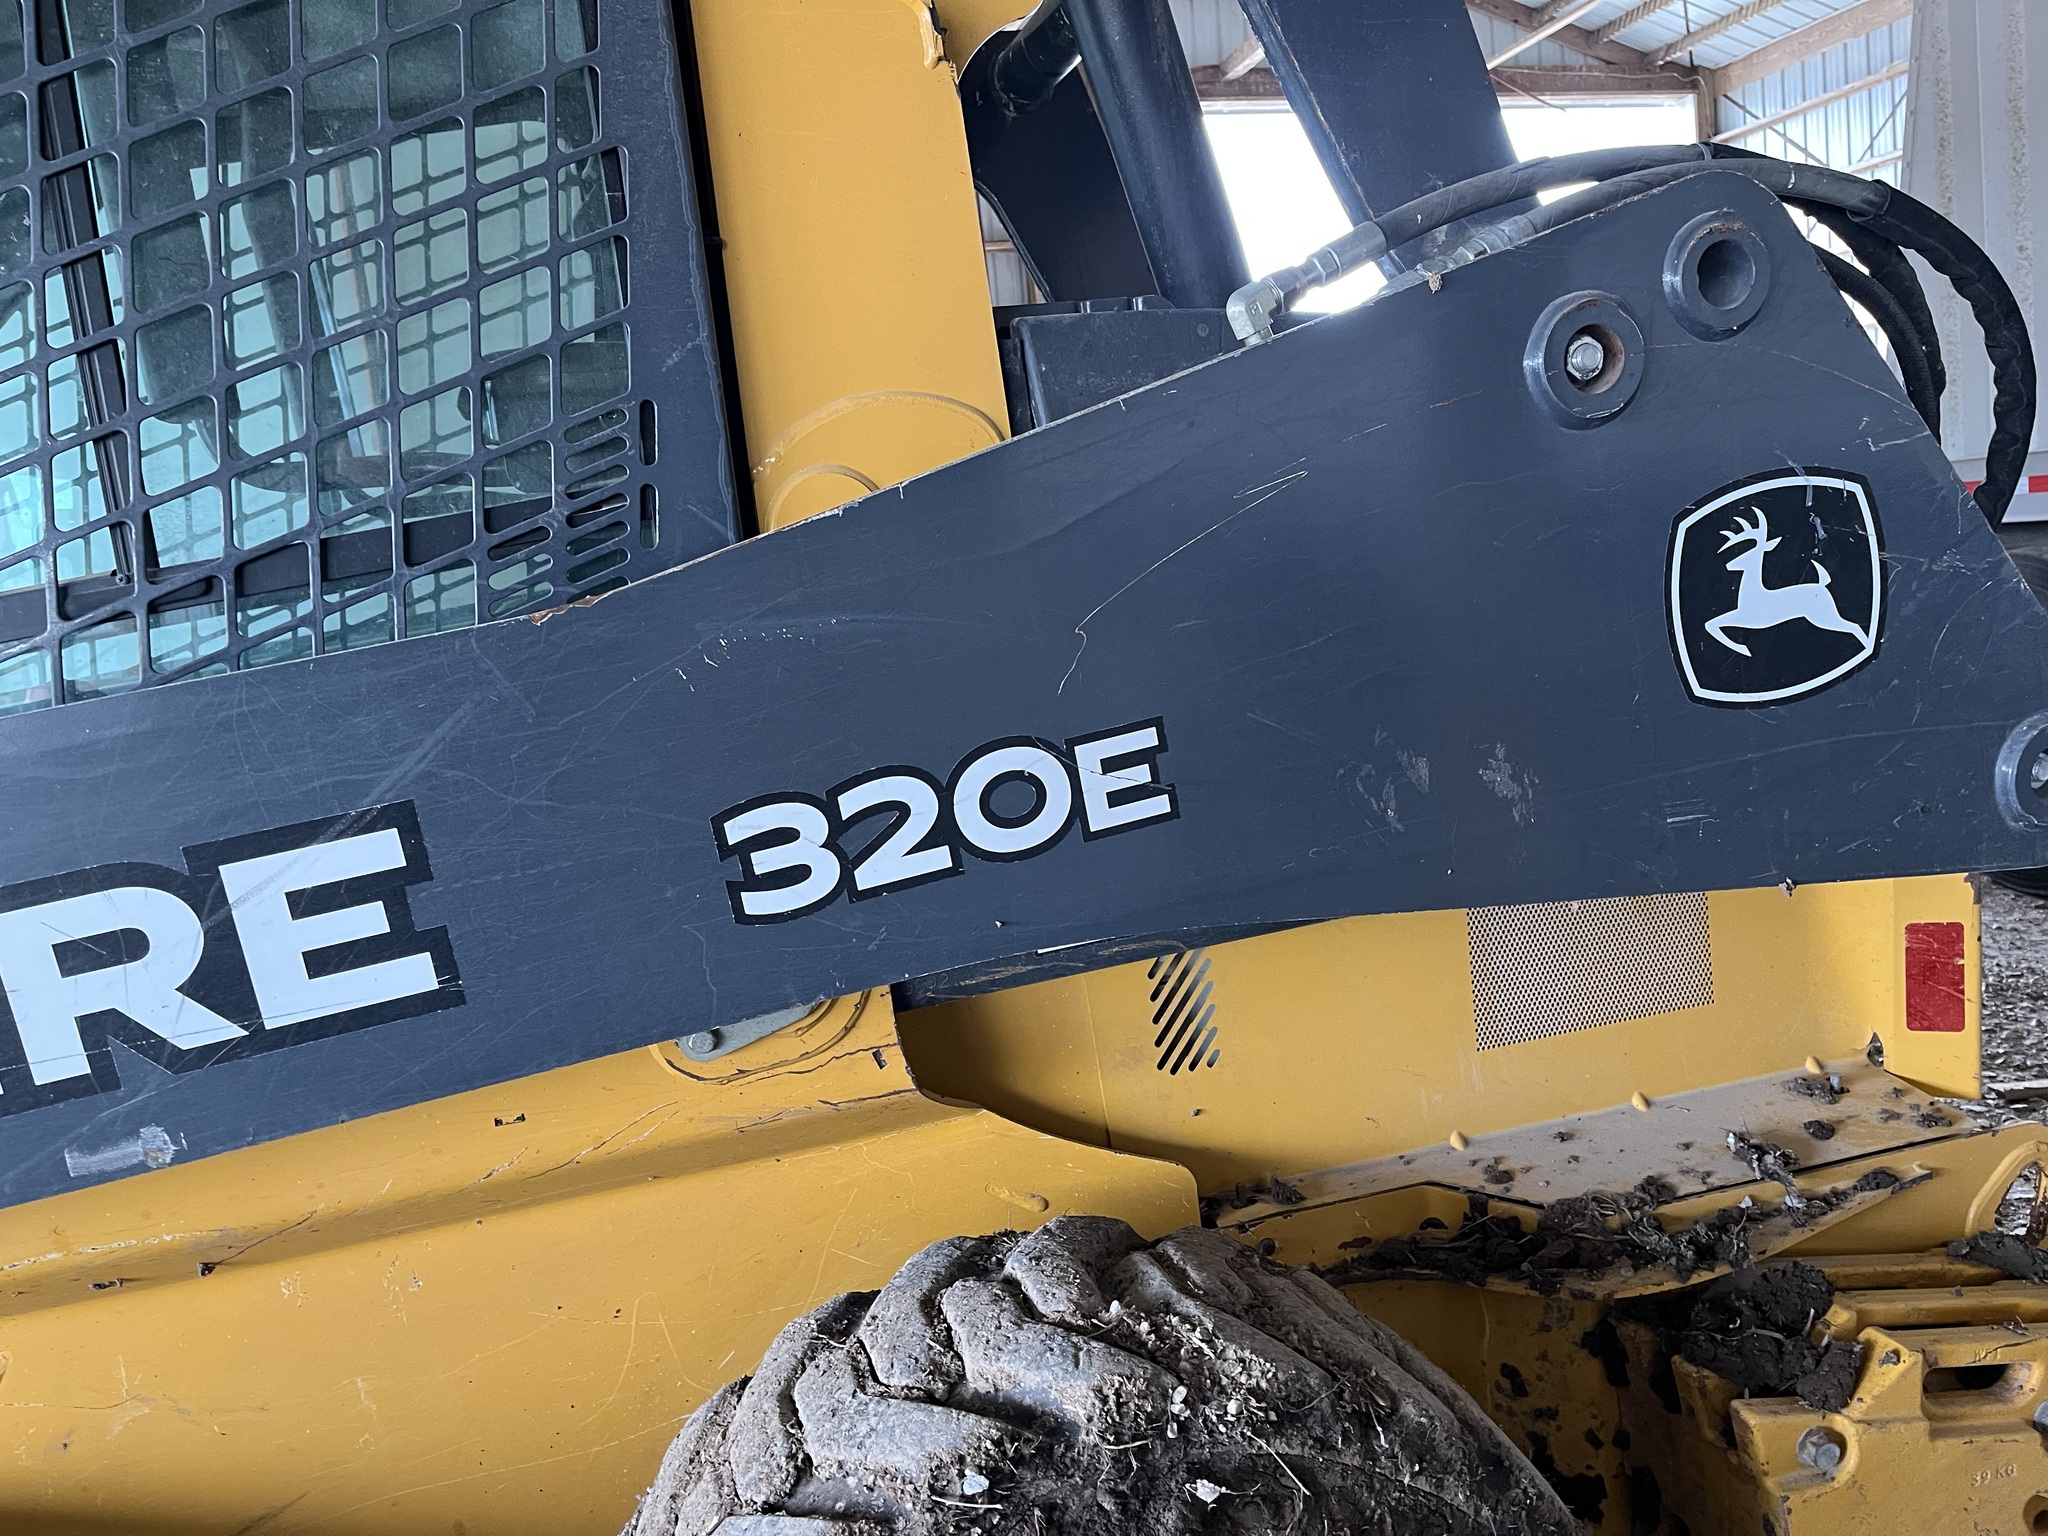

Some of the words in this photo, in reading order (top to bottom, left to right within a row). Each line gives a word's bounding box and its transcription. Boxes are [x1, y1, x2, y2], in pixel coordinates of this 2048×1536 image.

[722, 726, 1173, 917] 320E
[0, 827, 440, 1094] RE
[1995, 1462, 2018, 1480] KG
